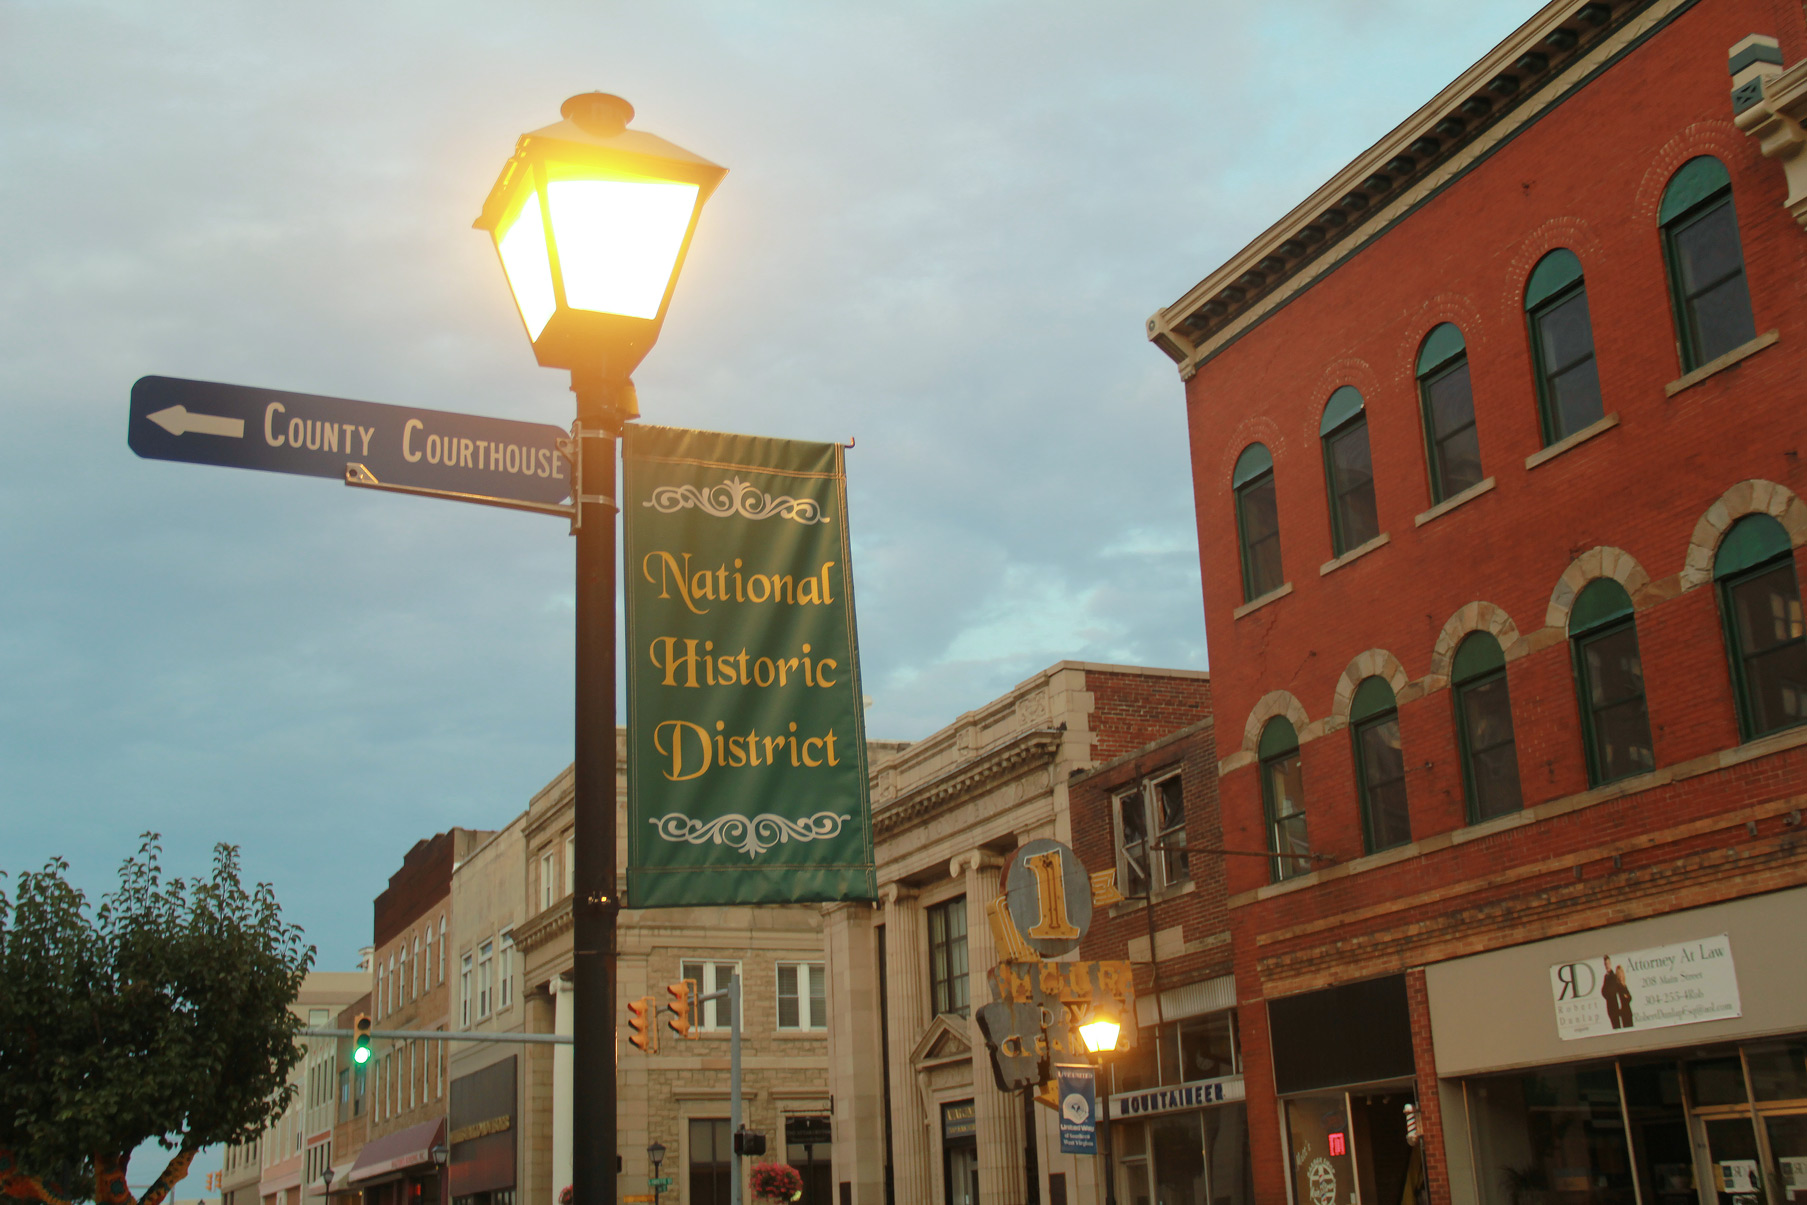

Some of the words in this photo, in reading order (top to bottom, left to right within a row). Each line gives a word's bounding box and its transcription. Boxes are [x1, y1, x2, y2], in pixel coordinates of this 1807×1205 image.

[264, 402, 375, 456] COUNTY
[402, 418, 564, 479] COURTHOUSE
[643, 551, 835, 614] National
[650, 636, 837, 688] Historic
[654, 720, 840, 781] District
[1024, 848, 1080, 939] 1
[1626, 954, 1675, 973] Attorney
[1681, 947, 1695, 963] At
[1700, 944, 1724, 960] Law
[1010, 964, 1119, 1002] HOUR
[1659, 975, 1678, 984] Main
[1680, 971, 1703, 982] Street
[1040, 1003, 1090, 1028] DRY
[1558, 1002, 1597, 1014] Robert
[1560, 1014, 1600, 1026] Dunlap
[1002, 1034, 1130, 1057] CLEANG
[1121, 1083, 1223, 1115] MOUNTAINEER
[1081, 1125, 1094, 1133] Way
